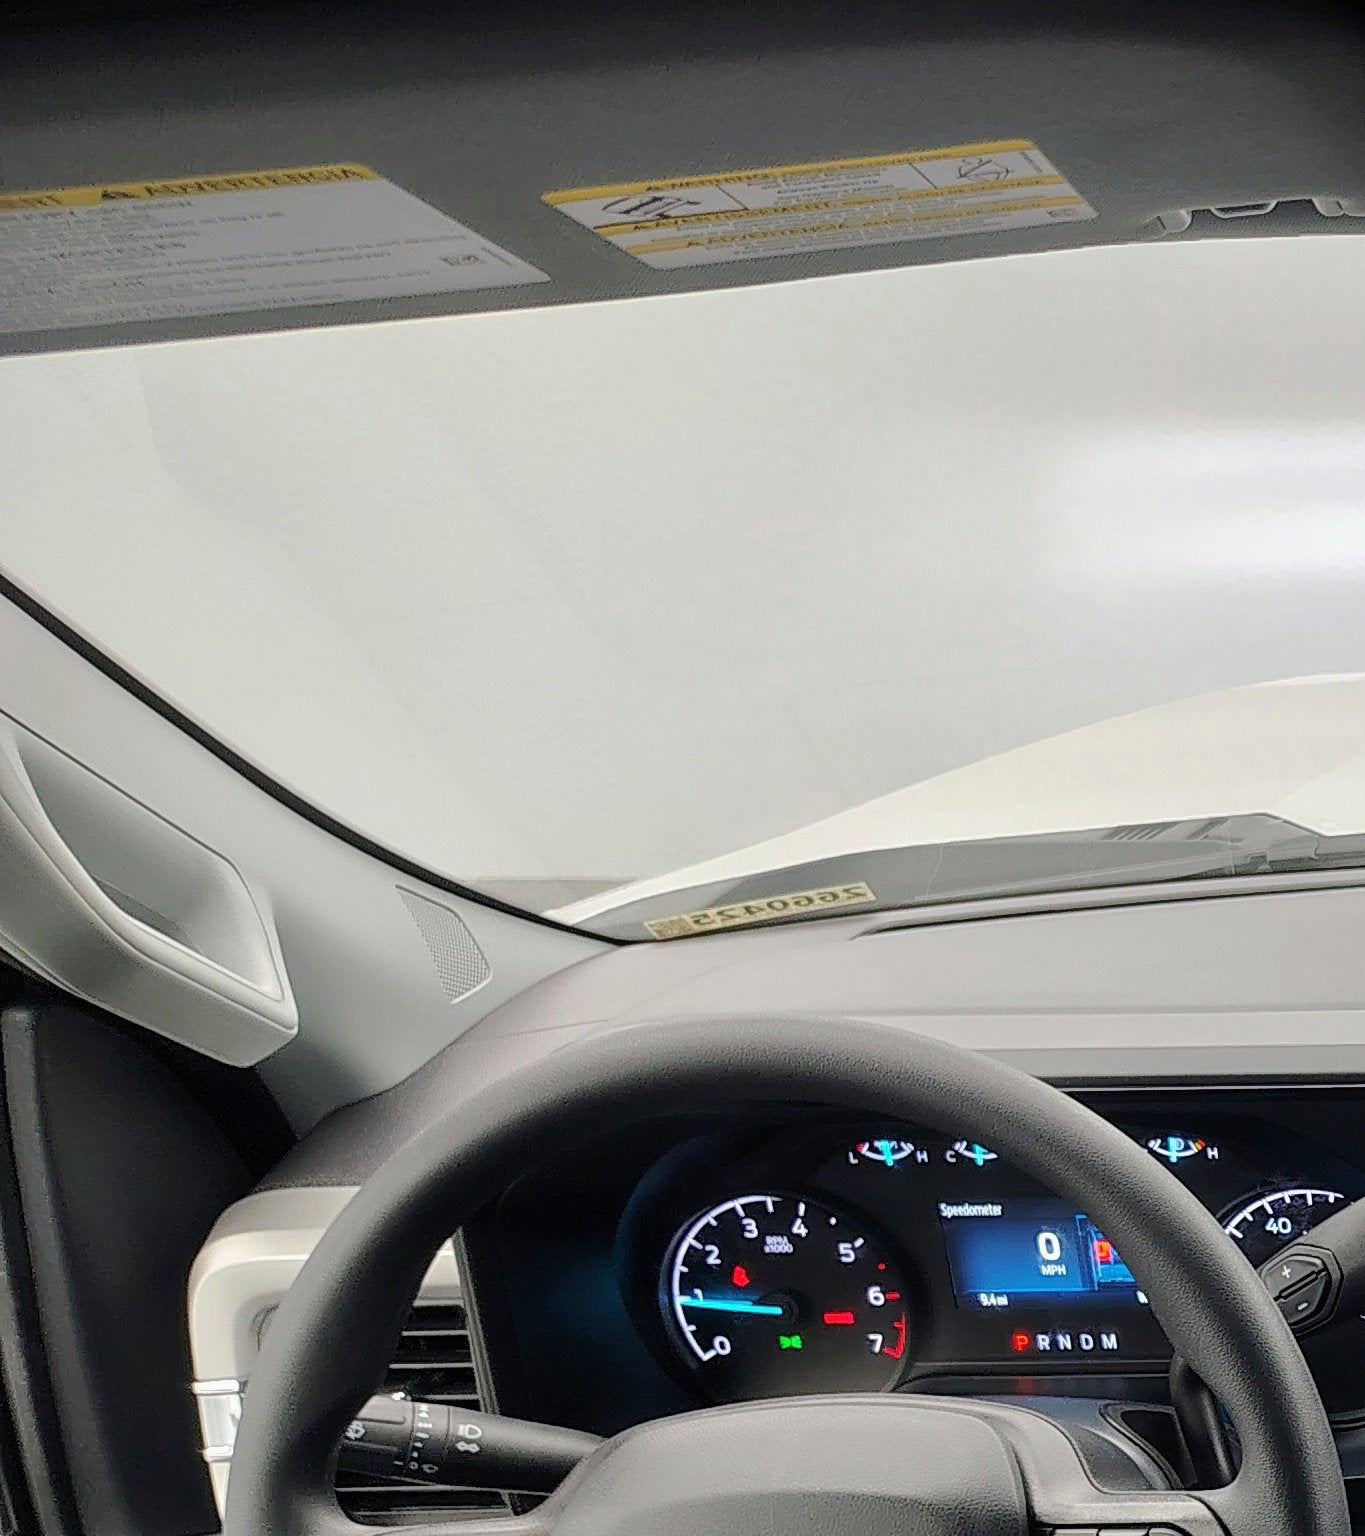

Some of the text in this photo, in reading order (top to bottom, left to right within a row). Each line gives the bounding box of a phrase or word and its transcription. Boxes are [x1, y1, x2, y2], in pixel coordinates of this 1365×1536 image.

[915, 1149, 929, 1163] H
[945, 1149, 957, 1163] C
[1206, 1146, 1219, 1160] H
[939, 1202, 1003, 1218] Speedometer
[742, 1218, 759, 1239] 3
[790, 1217, 809, 1238] 4
[1264, 1216, 1292, 1235] 40
[765, 1235, 789, 1245] RPM
[1037, 1231, 1061, 1261] 0
[704, 1244, 722, 1265] 2
[837, 1242, 856, 1263] 5
[1040, 1264, 1067, 1276] MPH
[867, 1285, 886, 1306] 6
[712, 1335, 731, 1355] 0
[867, 1333, 883, 1353] 7
[1015, 1333, 1118, 1351] P R N D M
